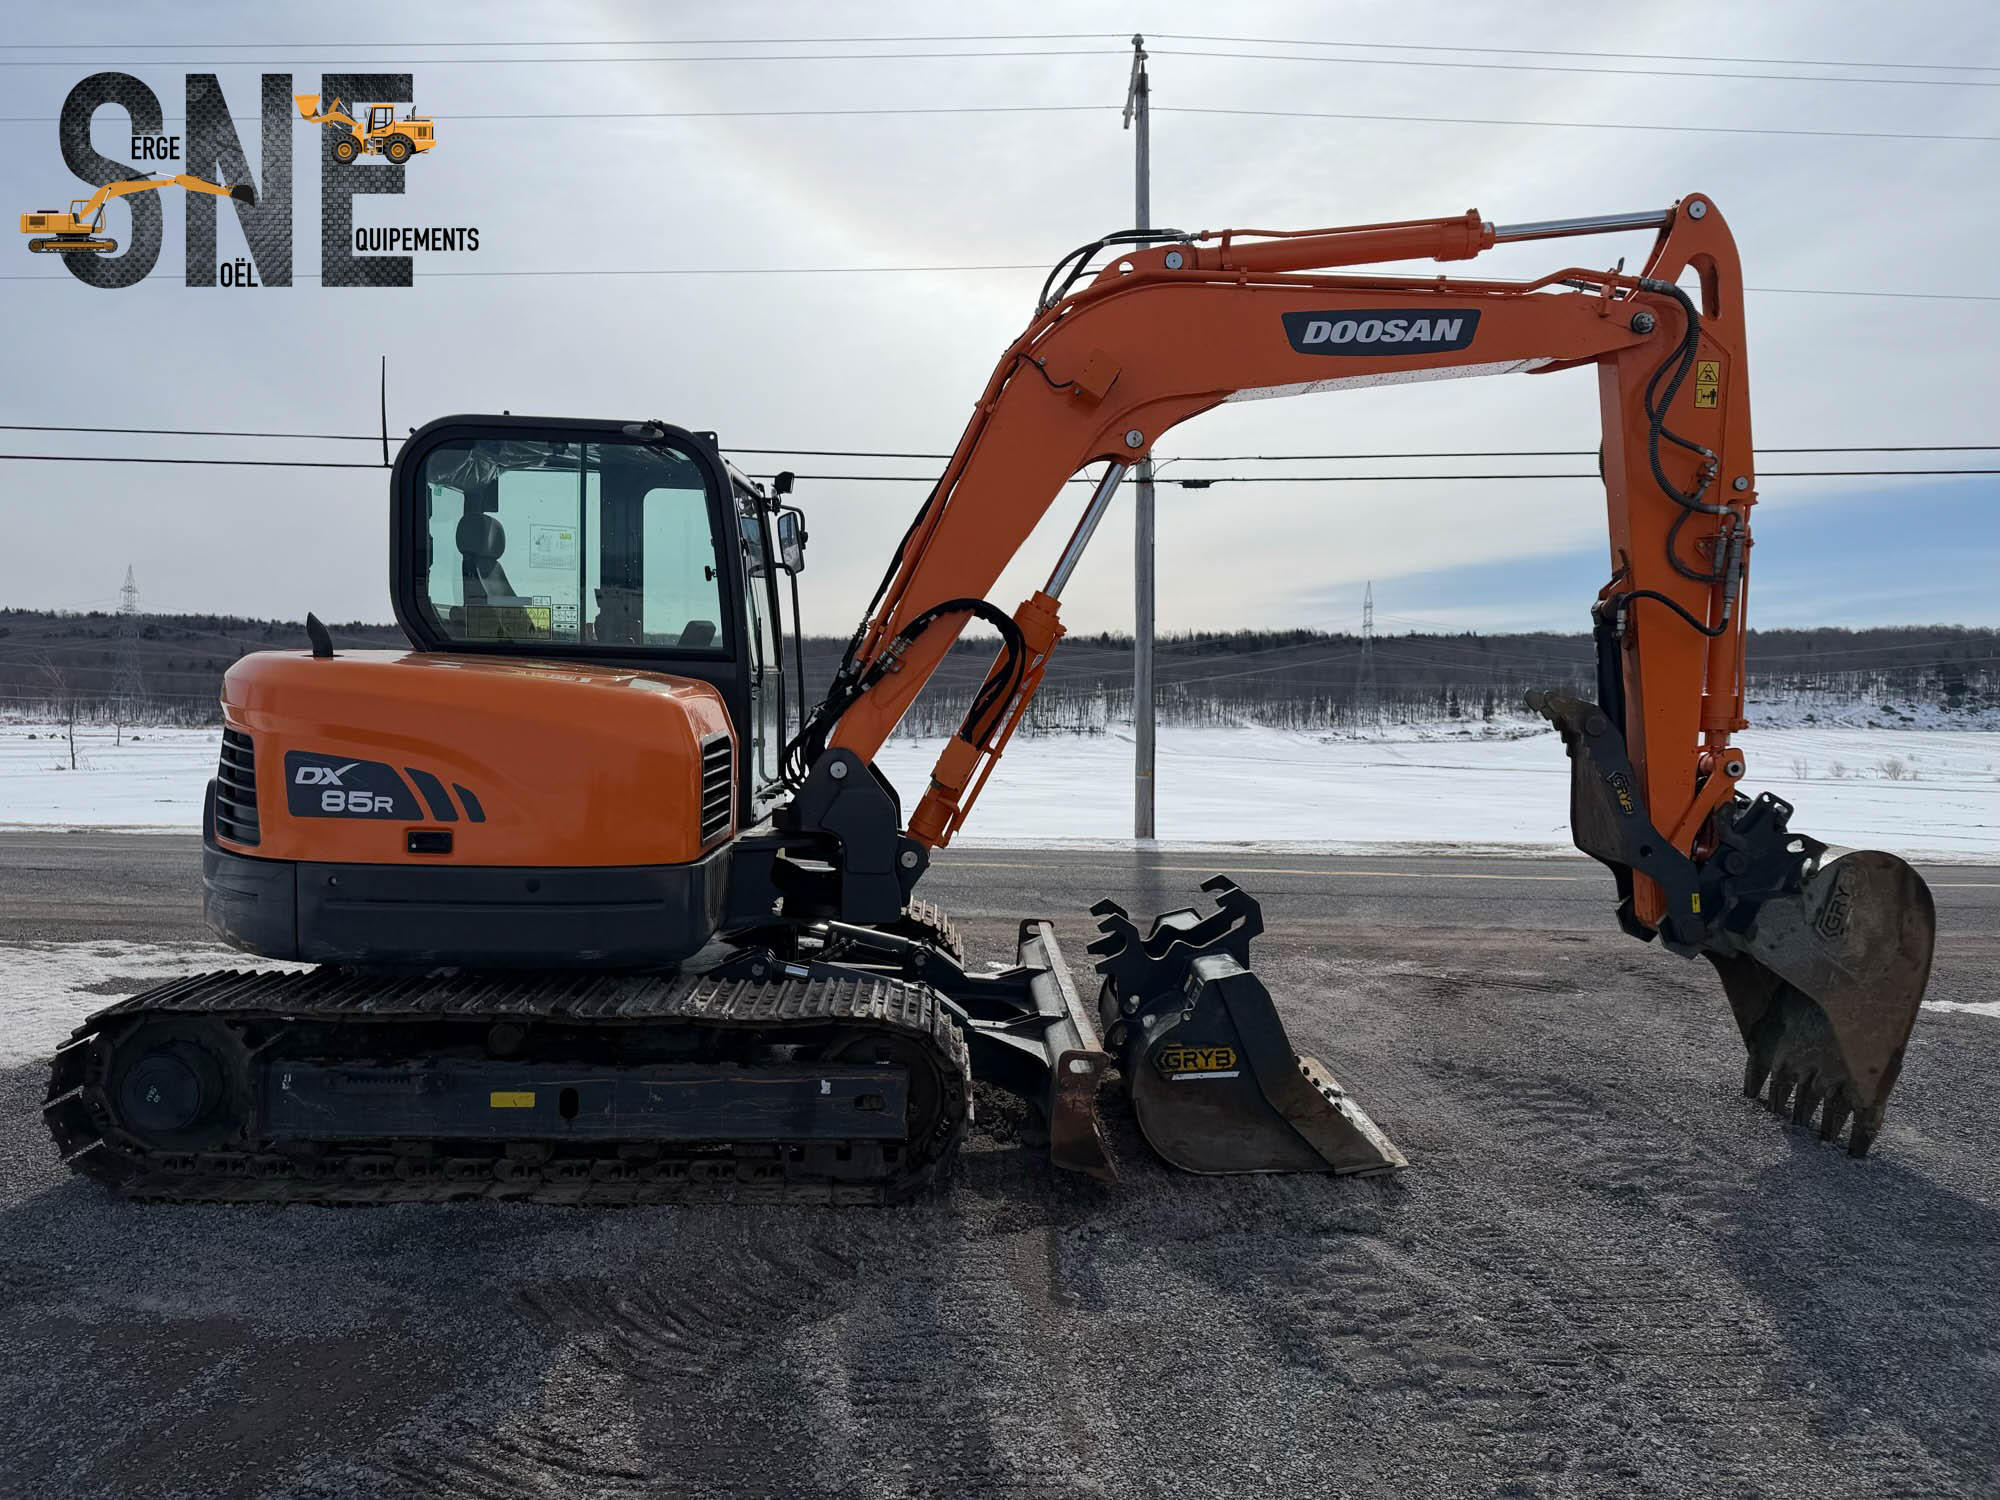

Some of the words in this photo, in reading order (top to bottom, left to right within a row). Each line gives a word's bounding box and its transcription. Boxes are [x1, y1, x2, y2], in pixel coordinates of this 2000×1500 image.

[1302, 319, 1463, 344] DOOSAN
[295, 763, 360, 785] DX
[321, 790, 393, 813] 85R
[1164, 1049, 1232, 1069] GRYB
